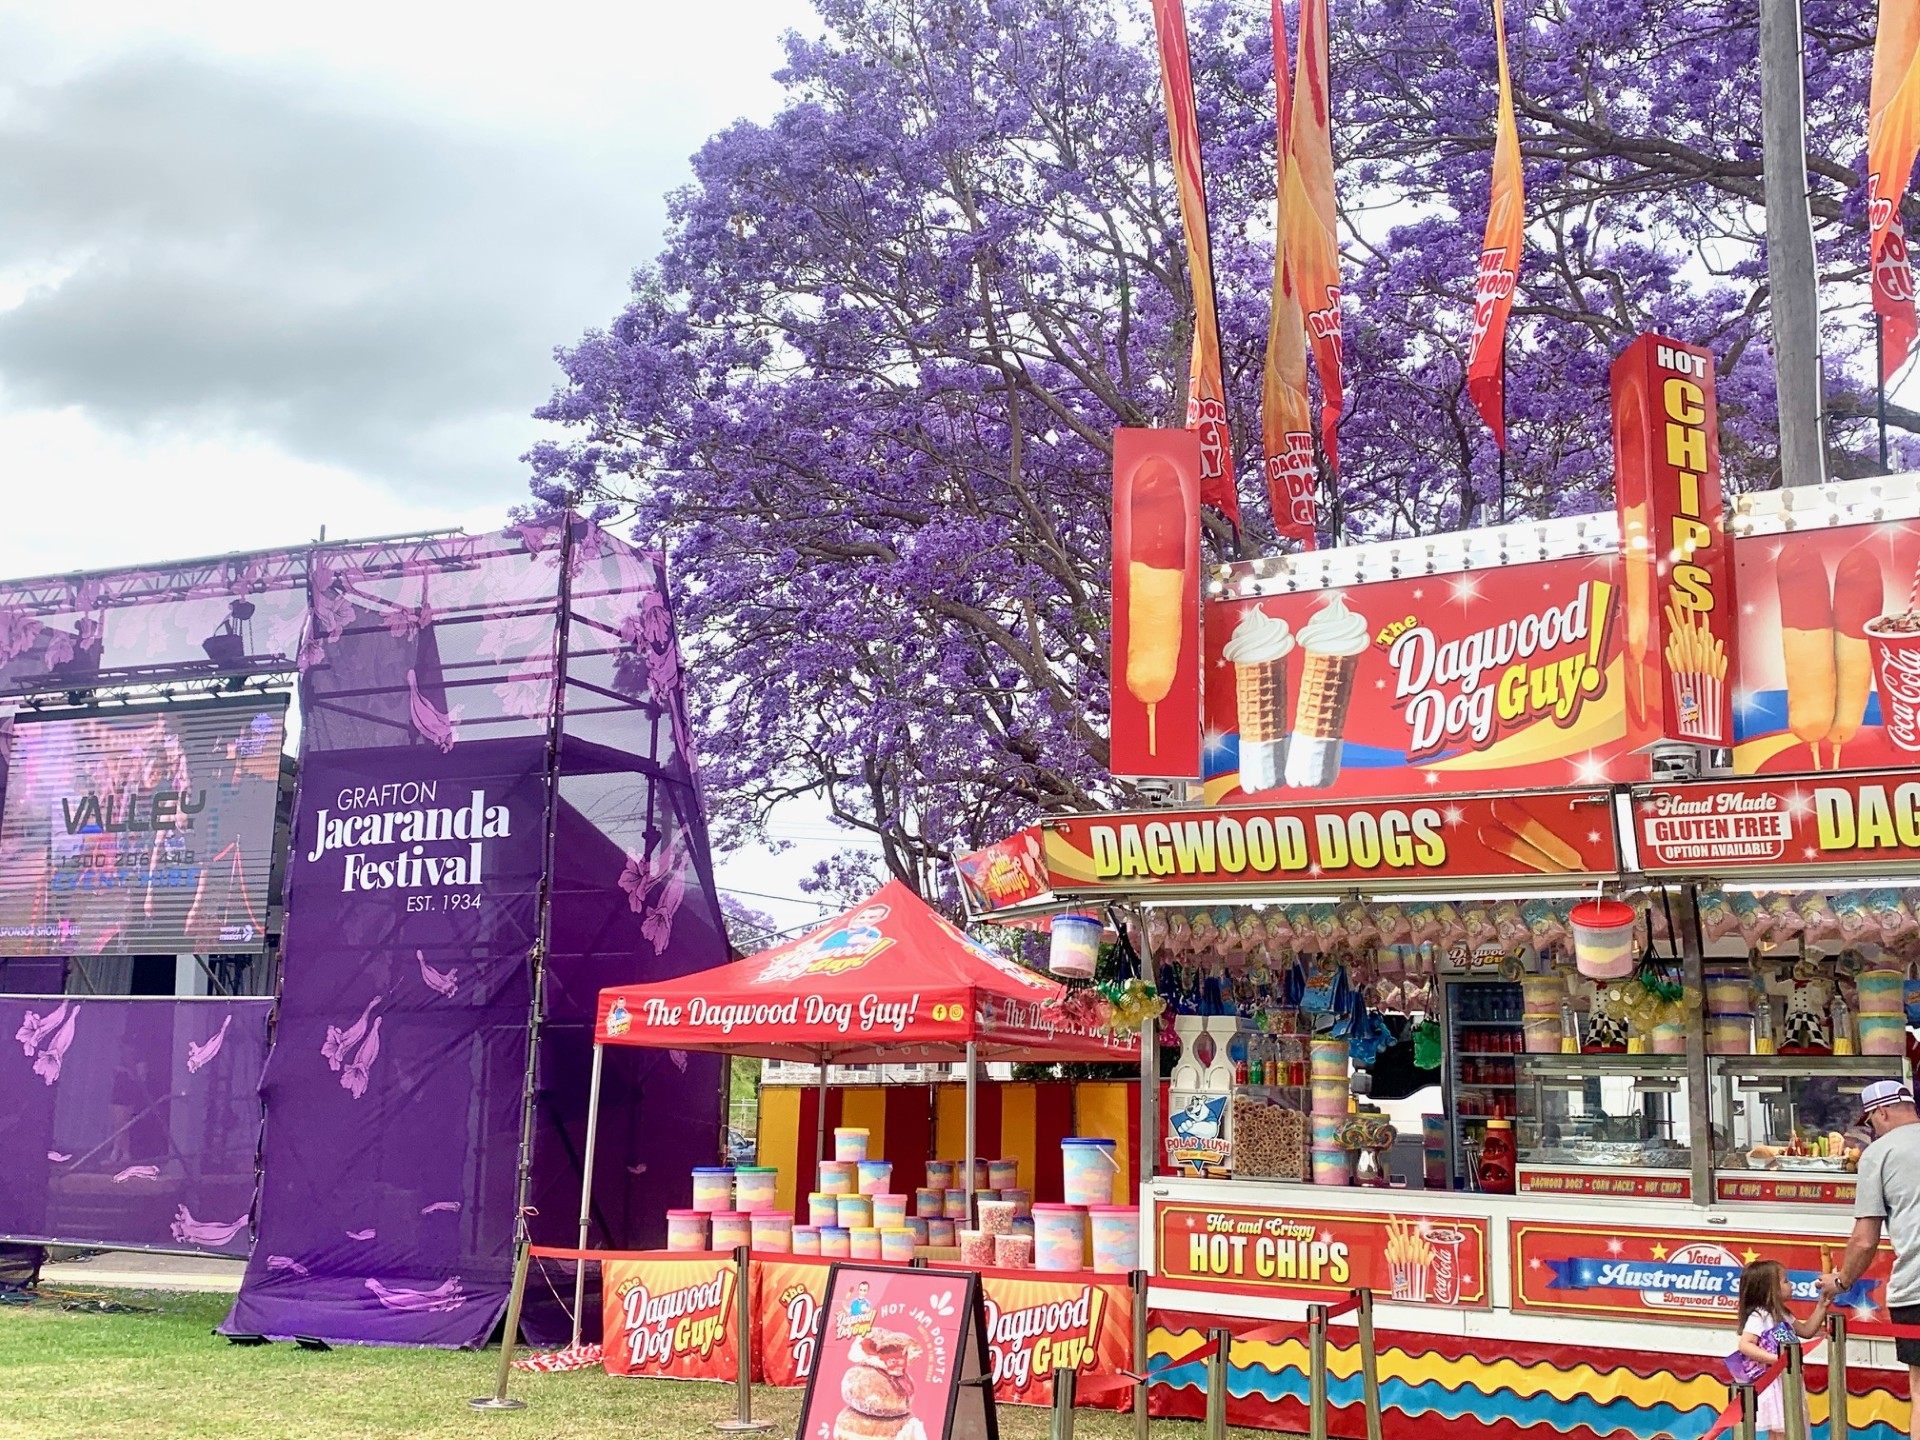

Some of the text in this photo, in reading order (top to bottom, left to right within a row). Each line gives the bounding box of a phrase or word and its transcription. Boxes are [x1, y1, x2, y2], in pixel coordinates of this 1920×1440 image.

[1657, 345, 1707, 378] HOT
[1663, 378, 1715, 612] CHIPS
[1376, 615, 1418, 647] The
[1389, 581, 1590, 699] Dagwood
[1405, 683, 1496, 752] Dog
[61, 789, 207, 835] VALLEY
[337, 781, 437, 811] GRAFTON
[1656, 792, 1777, 817] Hand Made
[307, 790, 511, 862] Jacaranda
[1655, 816, 1782, 842] GLUTEN FREE
[1090, 808, 1447, 878] DAGWOOD DOGS
[1665, 842, 1774, 860] OPTION AVAILABLE
[61, 854, 106, 868] 1300
[114, 852, 150, 868] 206
[341, 842, 483, 893] Festival
[407, 894, 482, 912] EST. 1934
[1449, 949, 1506, 959] Dgwoo
[643, 998, 682, 1027] The
[687, 996, 800, 1034] Dagwood
[804, 994, 852, 1033] Dog
[859, 993, 921, 1033] Guy!
[1003, 999, 1026, 1028] The
[1166, 1138, 1230, 1152] POLAR SLUSH
[1206, 1213, 1316, 1243] Hot and Crispy
[1189, 1232, 1350, 1283] HOT CHIPS
[1687, 1250, 1722, 1265] Voted
[617, 1277, 640, 1297] The
[781, 1285, 805, 1304] The
[1597, 1263, 1820, 1298] Australia's est
[623, 1270, 724, 1333] Dagwood
[1663, 1291, 1715, 1306] Dagwood
[628, 1326, 675, 1366] Dog
[881, 1303, 946, 1384] HOT JAM DONUTS
